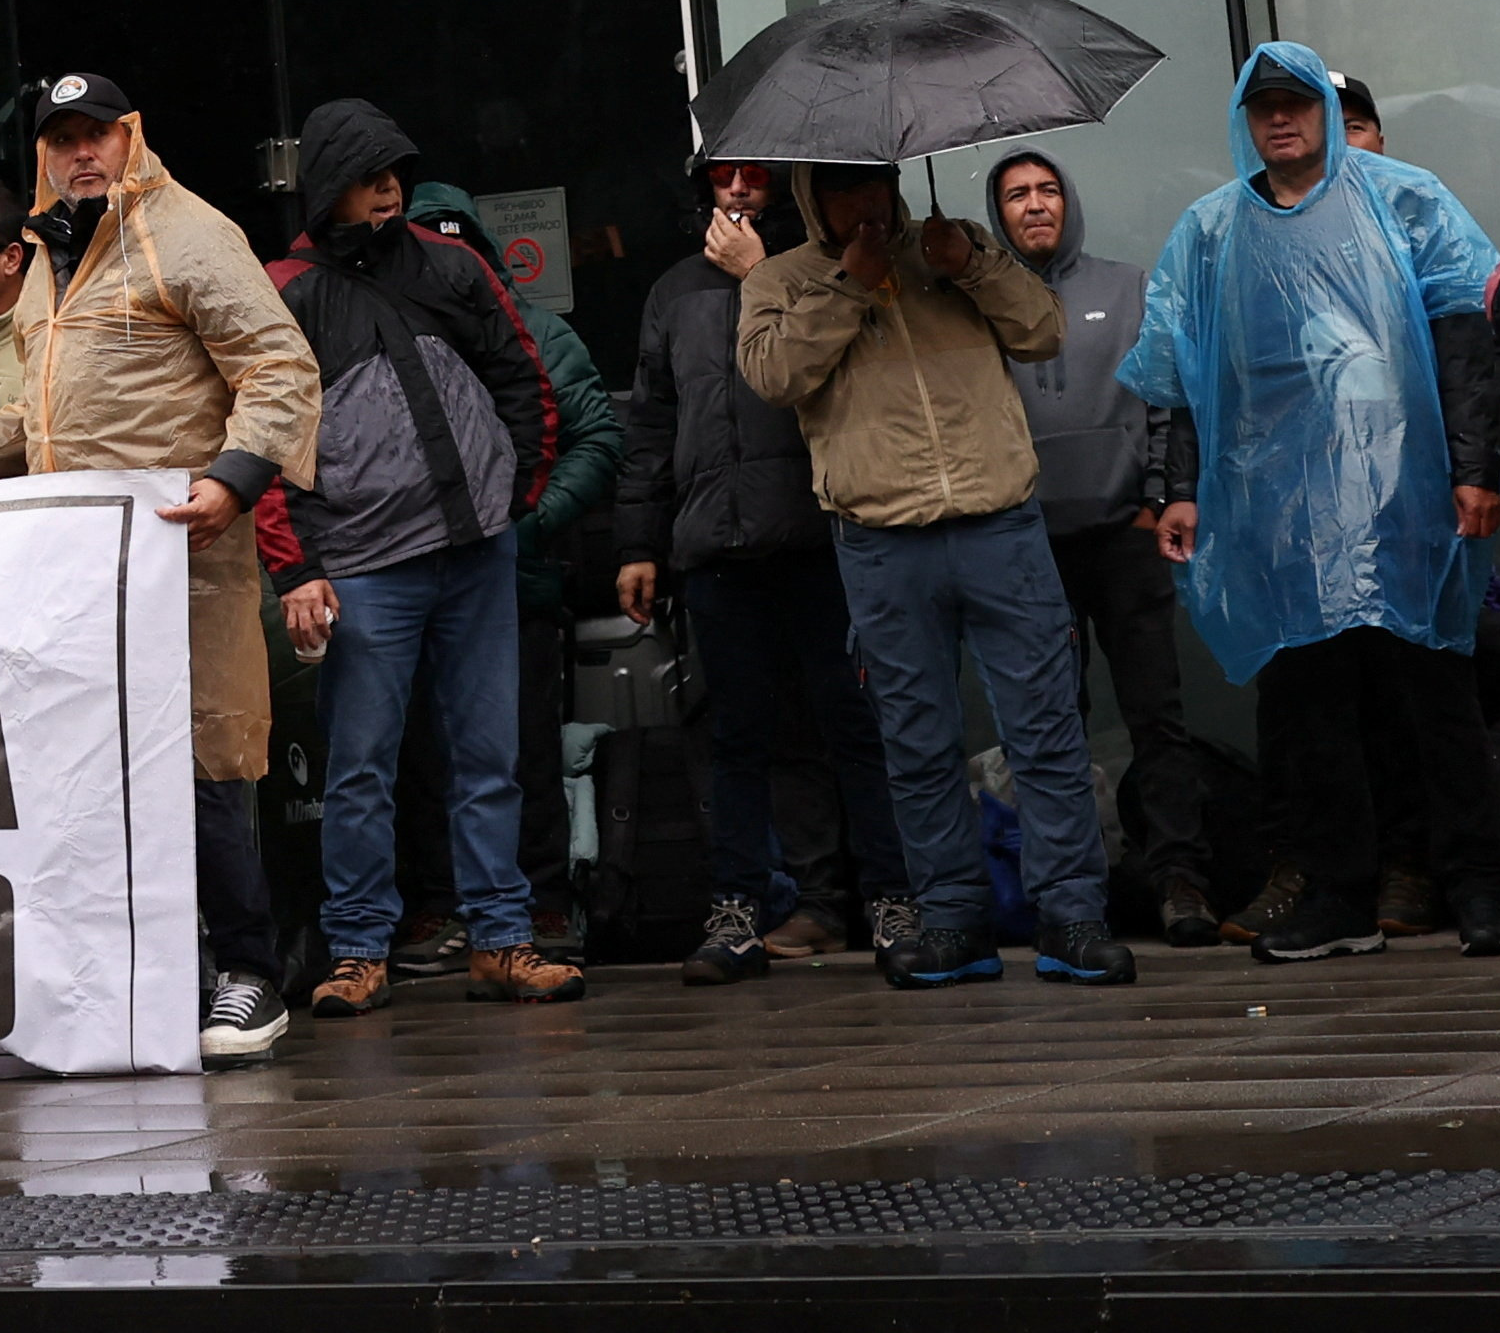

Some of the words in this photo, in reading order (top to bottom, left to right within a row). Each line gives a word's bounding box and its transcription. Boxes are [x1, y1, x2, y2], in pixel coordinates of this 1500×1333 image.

[504, 210, 537, 224] FUMAR
[440, 221, 461, 234] CAT
[497, 224, 520, 236] ESTE
[522, 219, 562, 233] ESPACIO
